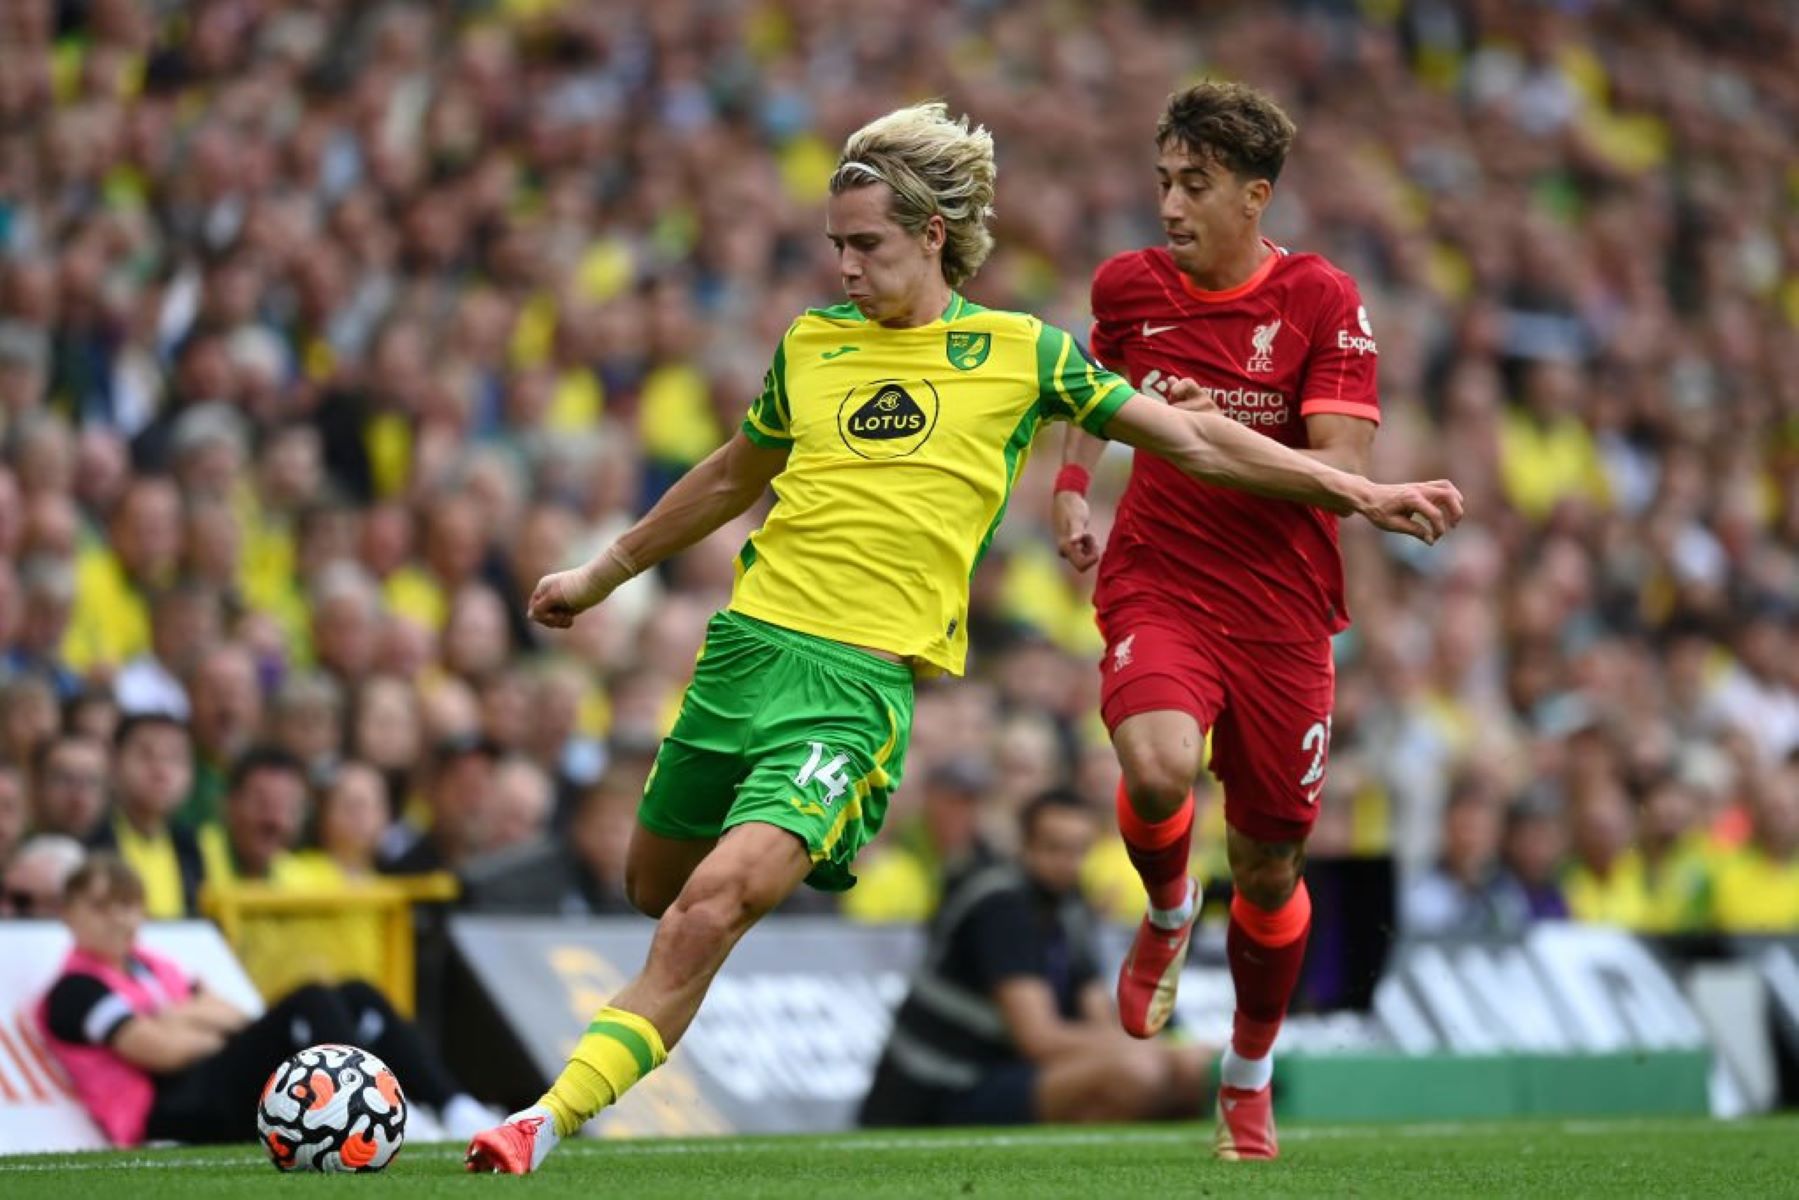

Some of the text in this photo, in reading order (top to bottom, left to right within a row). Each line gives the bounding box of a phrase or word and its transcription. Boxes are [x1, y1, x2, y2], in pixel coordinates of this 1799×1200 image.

[1246, 360, 1274, 373] LFC
[854, 414, 921, 431] LOTUS
[794, 741, 850, 806] 14
